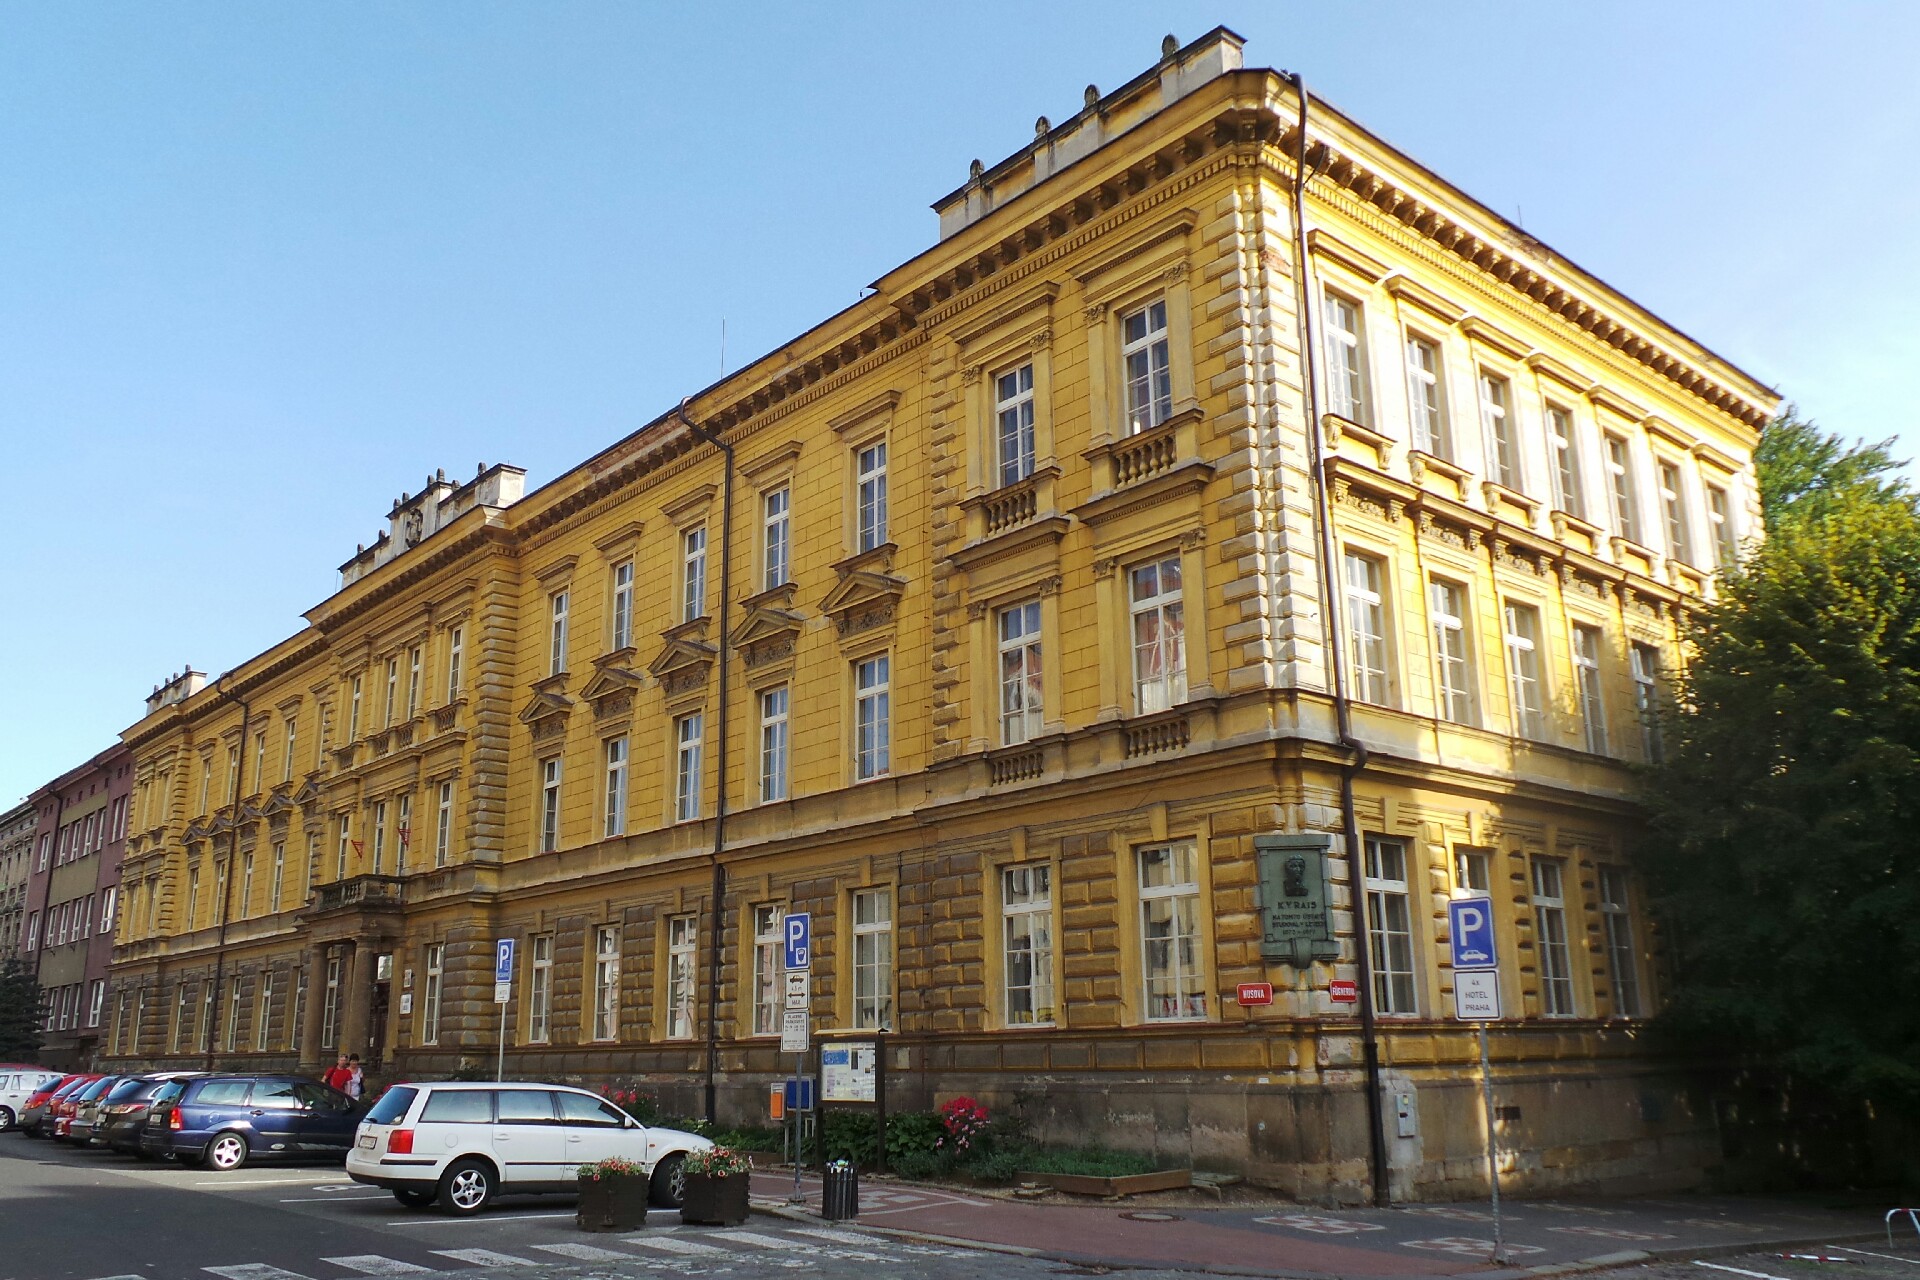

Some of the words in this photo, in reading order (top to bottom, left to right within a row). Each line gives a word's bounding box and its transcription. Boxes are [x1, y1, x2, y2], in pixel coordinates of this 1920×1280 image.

[789, 920, 804, 952] P
[1457, 907, 1484, 947] P
[500, 944, 510, 969] P
[1465, 991, 1488, 999] HOTEL
